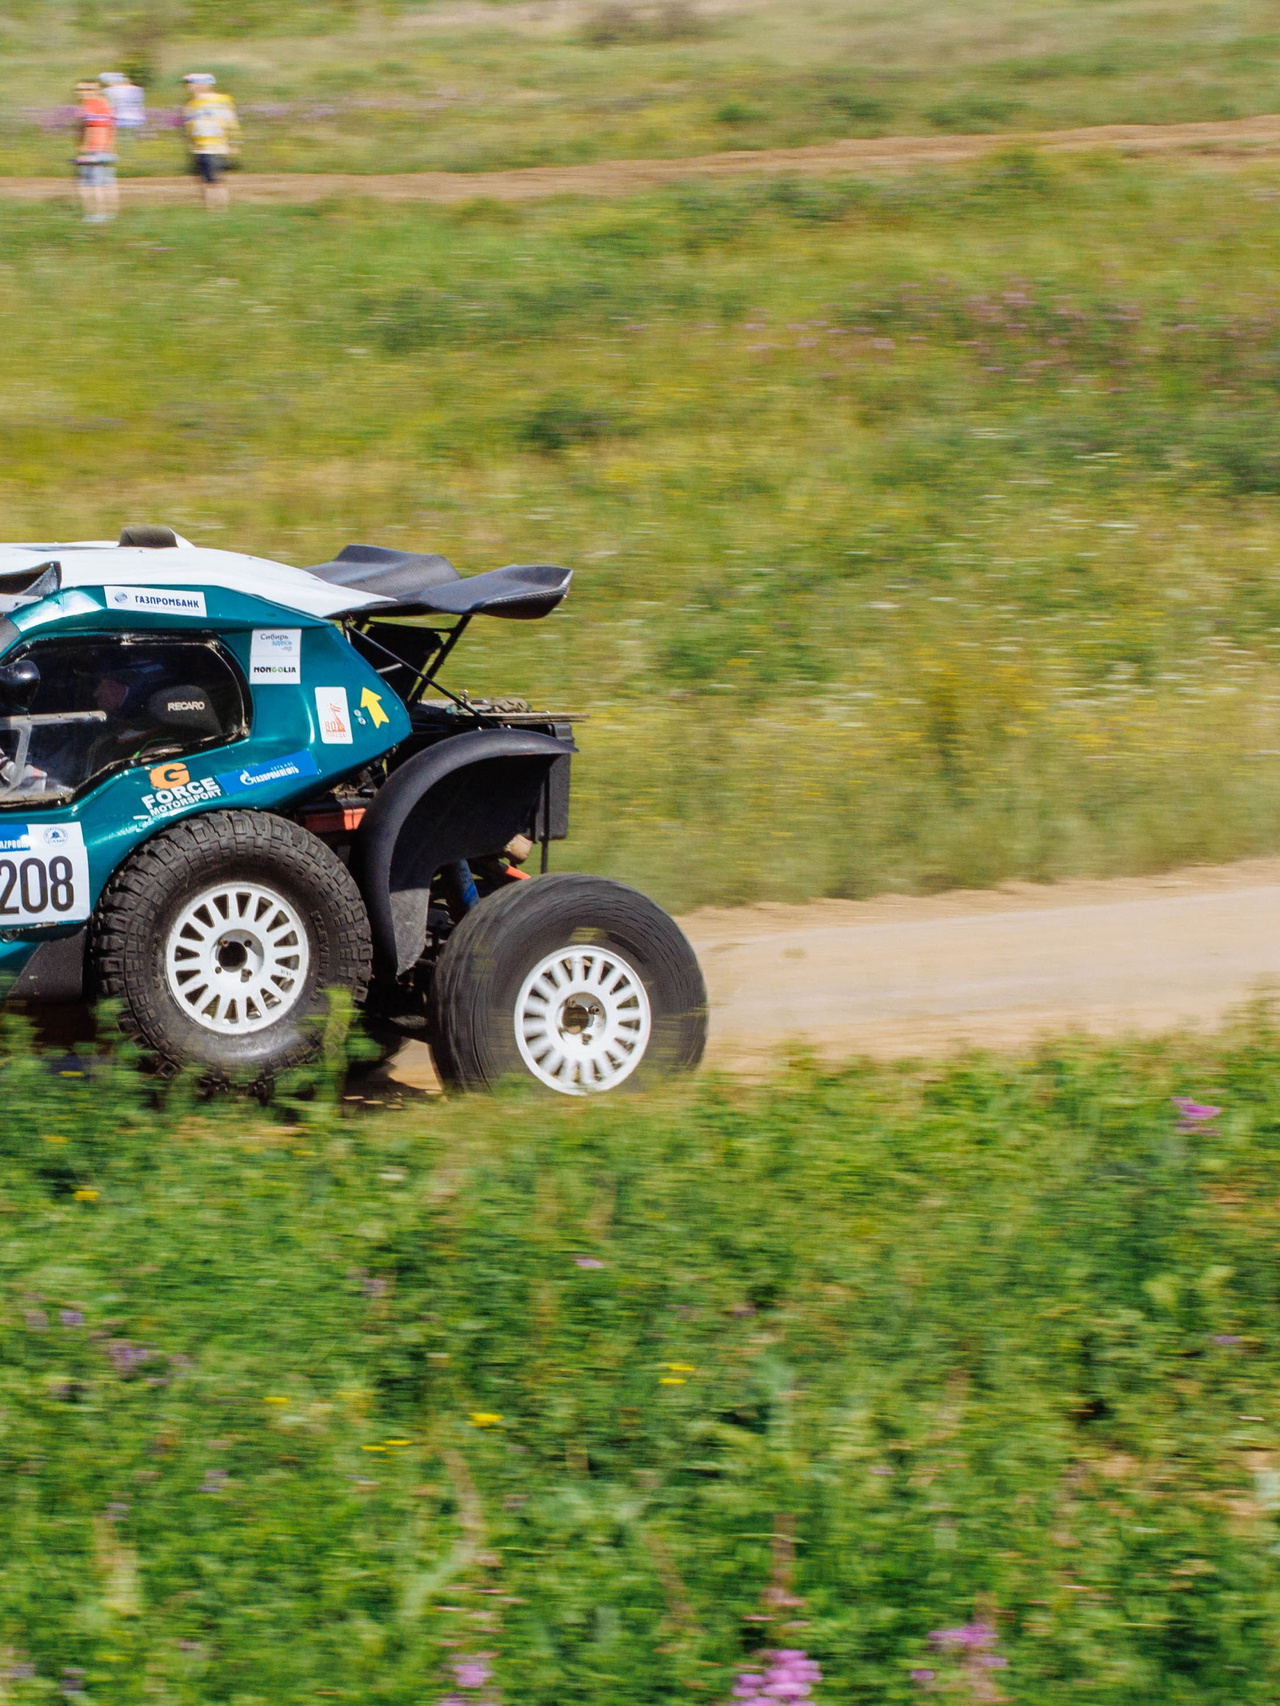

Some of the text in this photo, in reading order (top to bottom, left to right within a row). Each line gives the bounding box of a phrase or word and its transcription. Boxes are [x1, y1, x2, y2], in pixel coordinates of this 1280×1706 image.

[135, 595, 199, 608] ГАЗПРОМБАНК
[167, 701, 205, 712] RECARO
[149, 762, 190, 790] G
[141, 777, 220, 809] FORCE
[149, 789, 222, 816] MOTORSPORT
